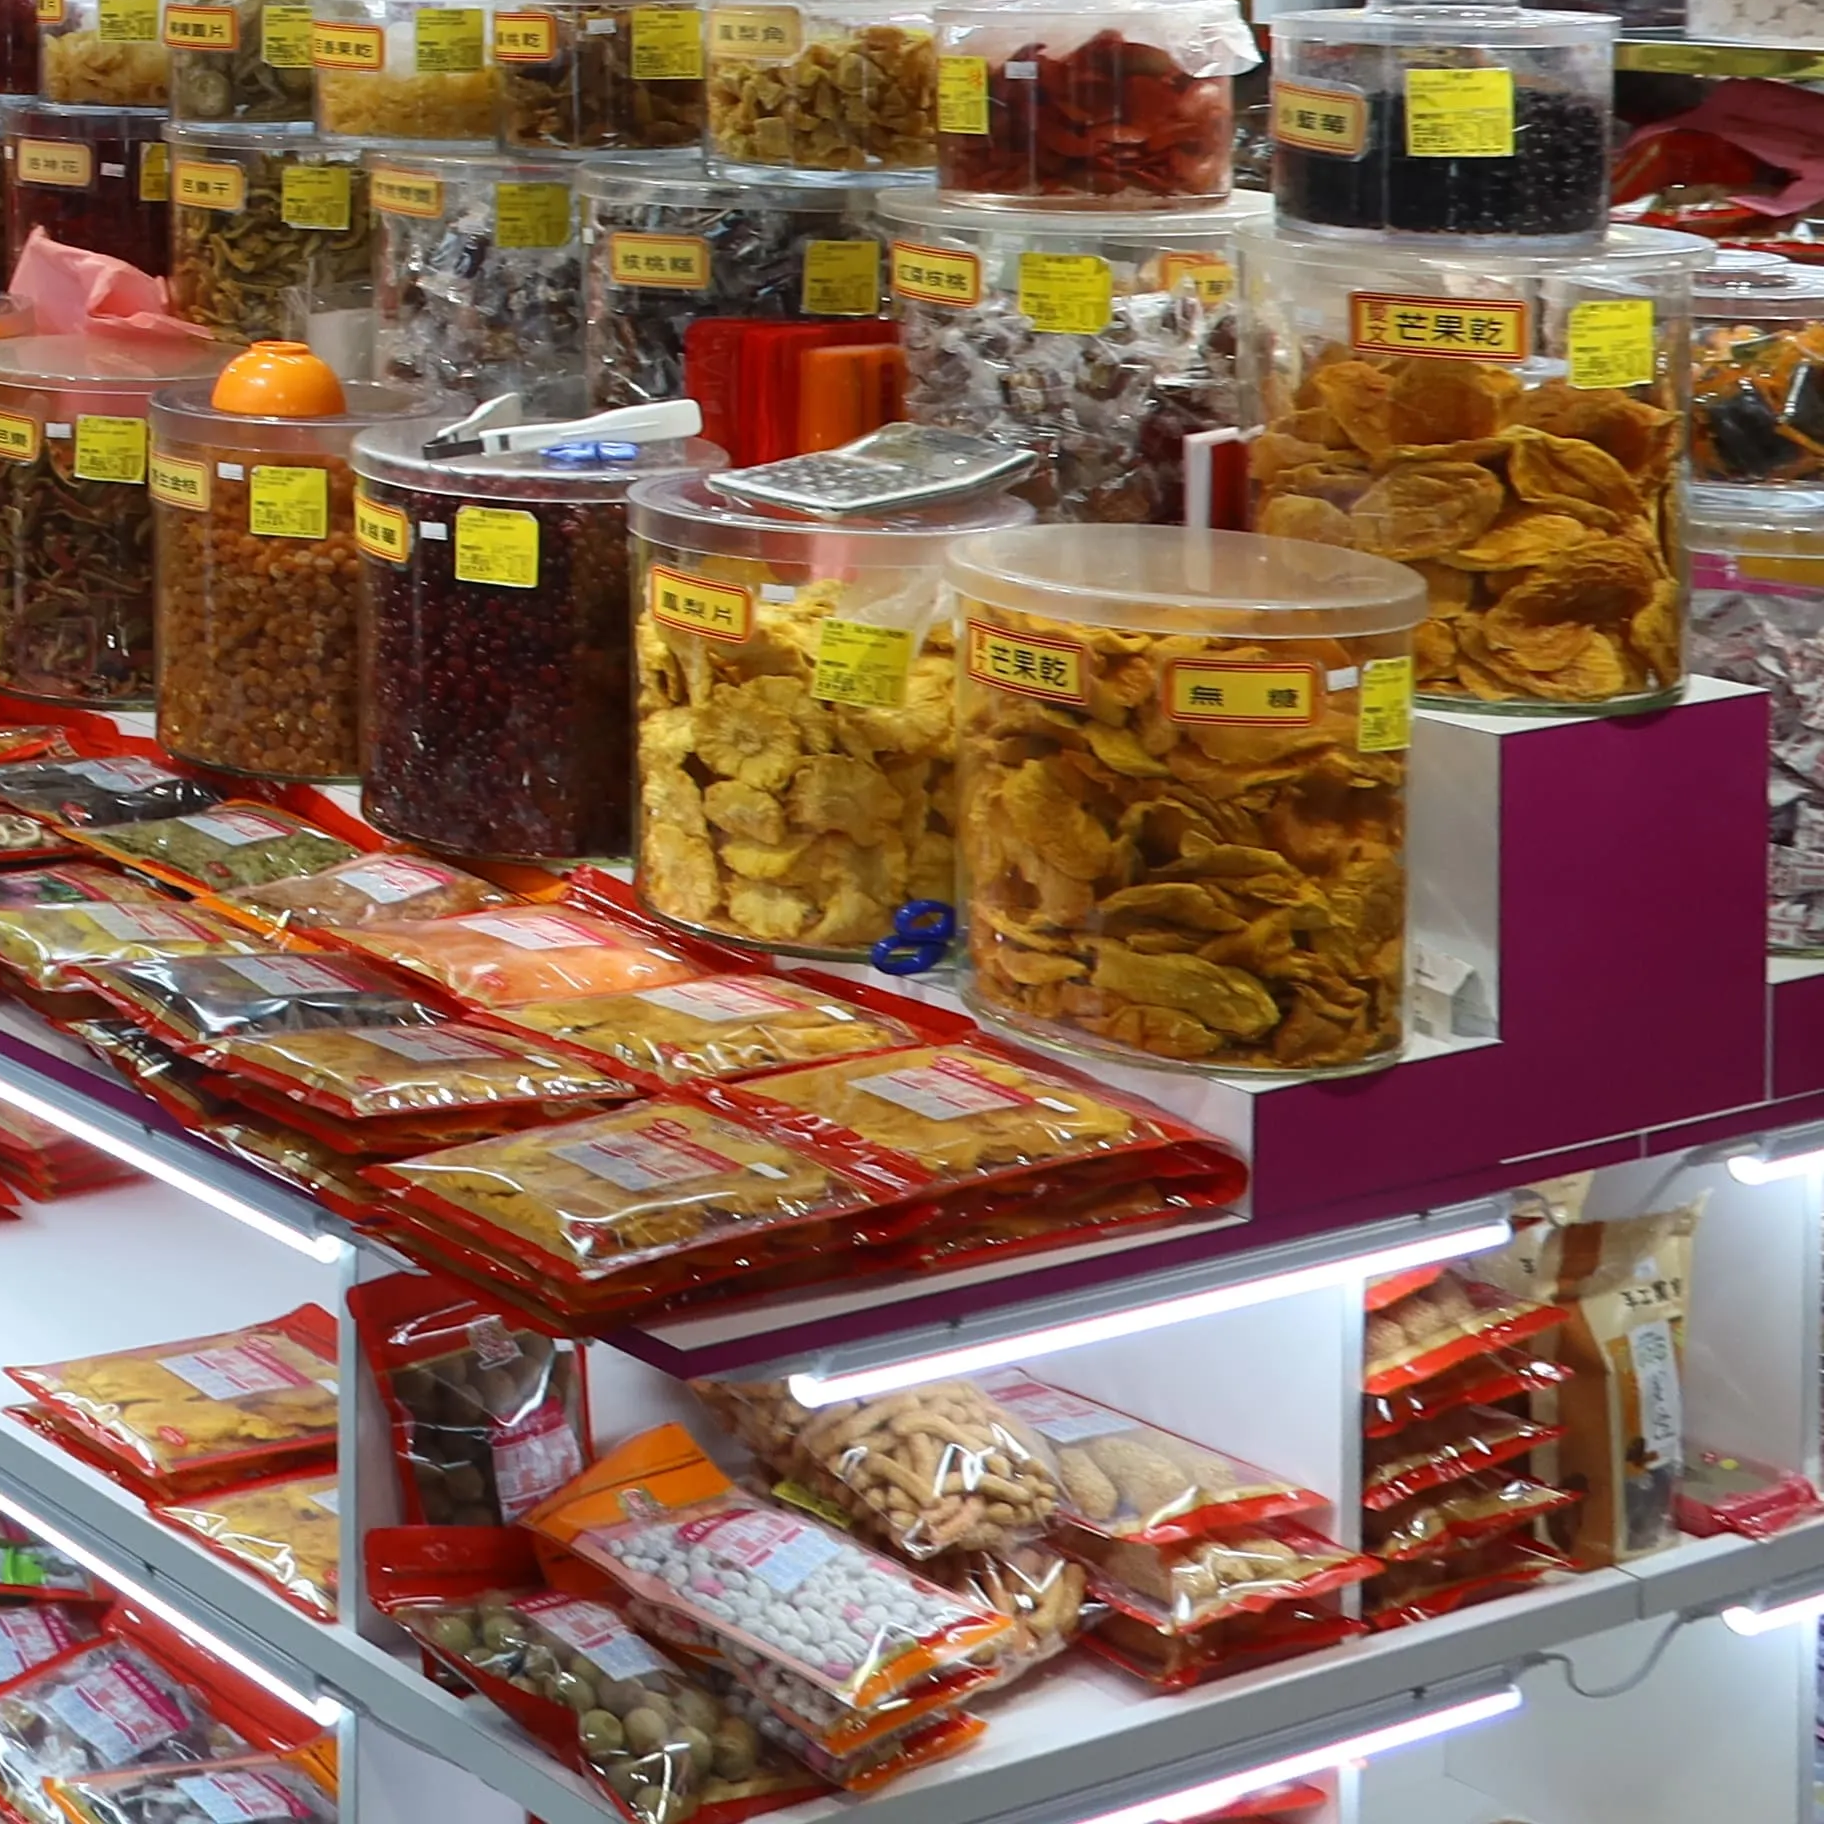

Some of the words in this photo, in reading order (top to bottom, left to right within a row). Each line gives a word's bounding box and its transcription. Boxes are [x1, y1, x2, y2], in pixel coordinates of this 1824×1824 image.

[1393, 310, 1506, 348] 芒果乾
[989, 645, 1068, 689] 芒果乾
